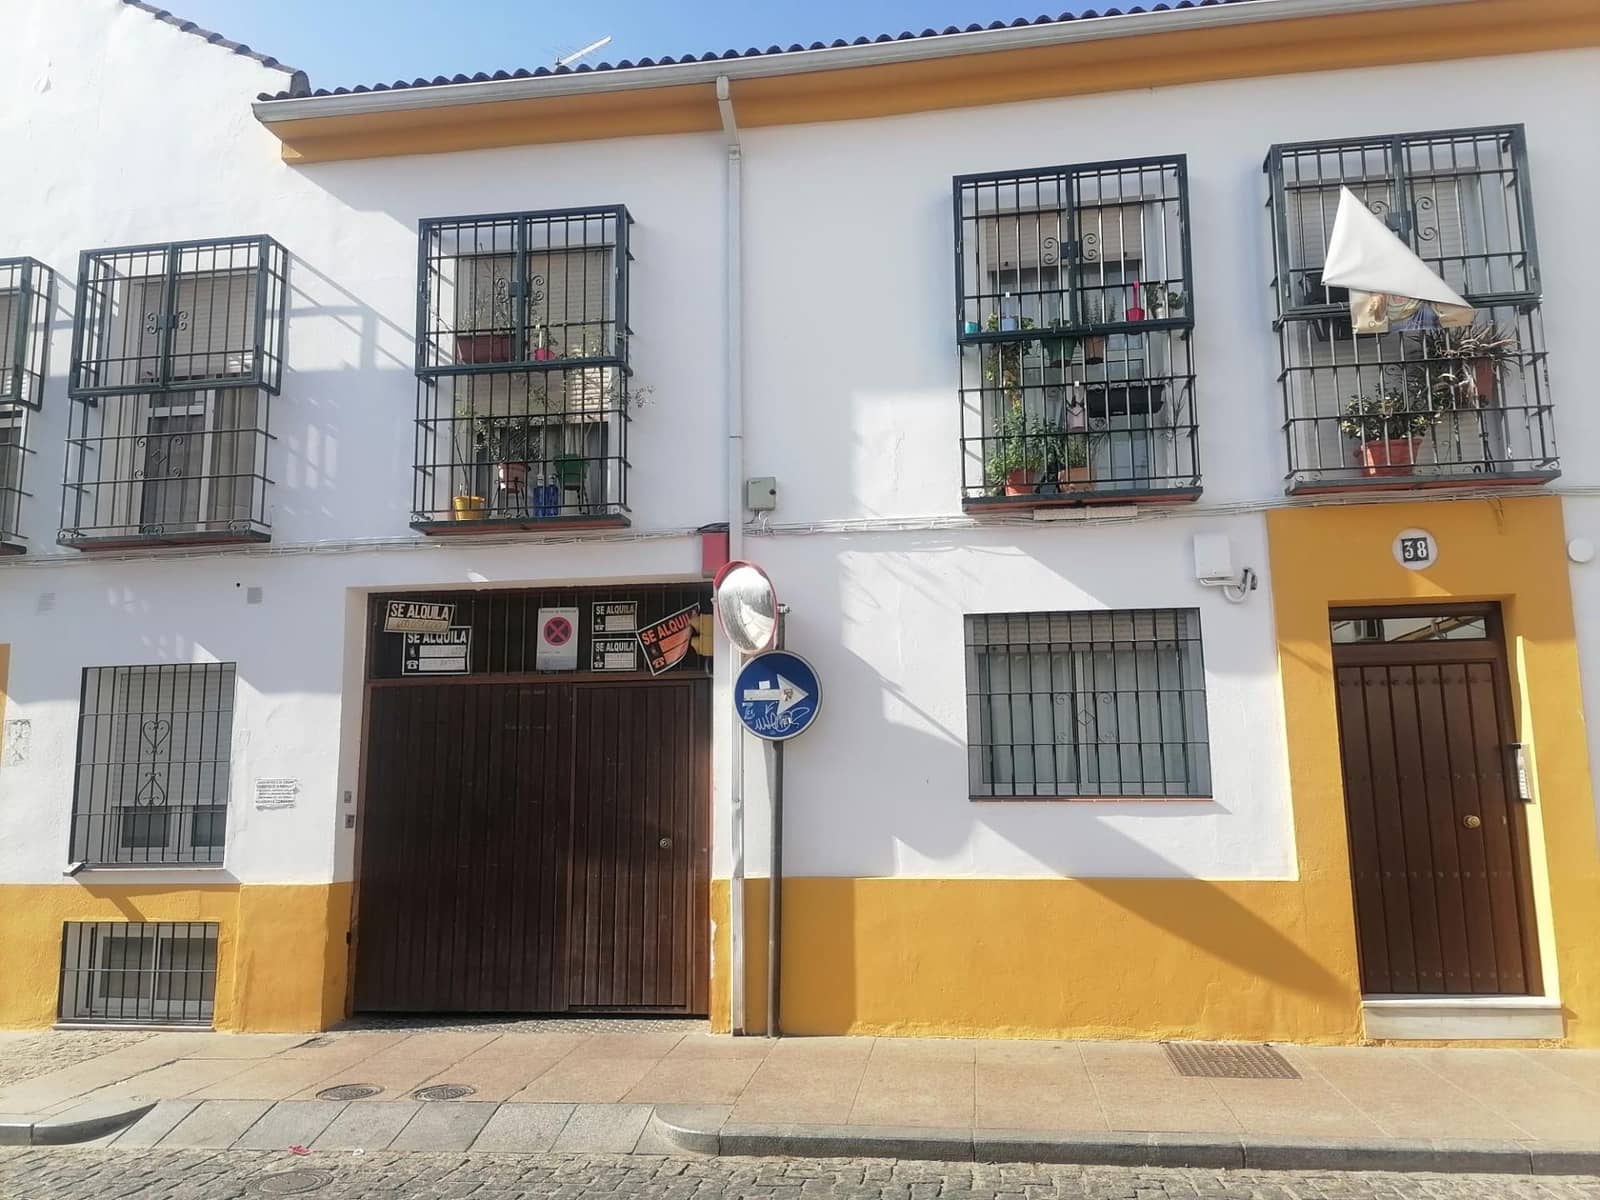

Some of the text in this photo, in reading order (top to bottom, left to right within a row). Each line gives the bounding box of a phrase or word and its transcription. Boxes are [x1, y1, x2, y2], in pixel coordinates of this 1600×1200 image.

[1404, 540, 1427, 559] 38
[391, 603, 449, 620] SE ALQUILA
[595, 604, 635, 615] SE ALQUILA
[641, 629, 657, 645] SE
[657, 607, 697, 639] ALQUI
[407, 630, 467, 644] SE ALQUILA
[595, 641, 634, 652] SE ALQUILA
